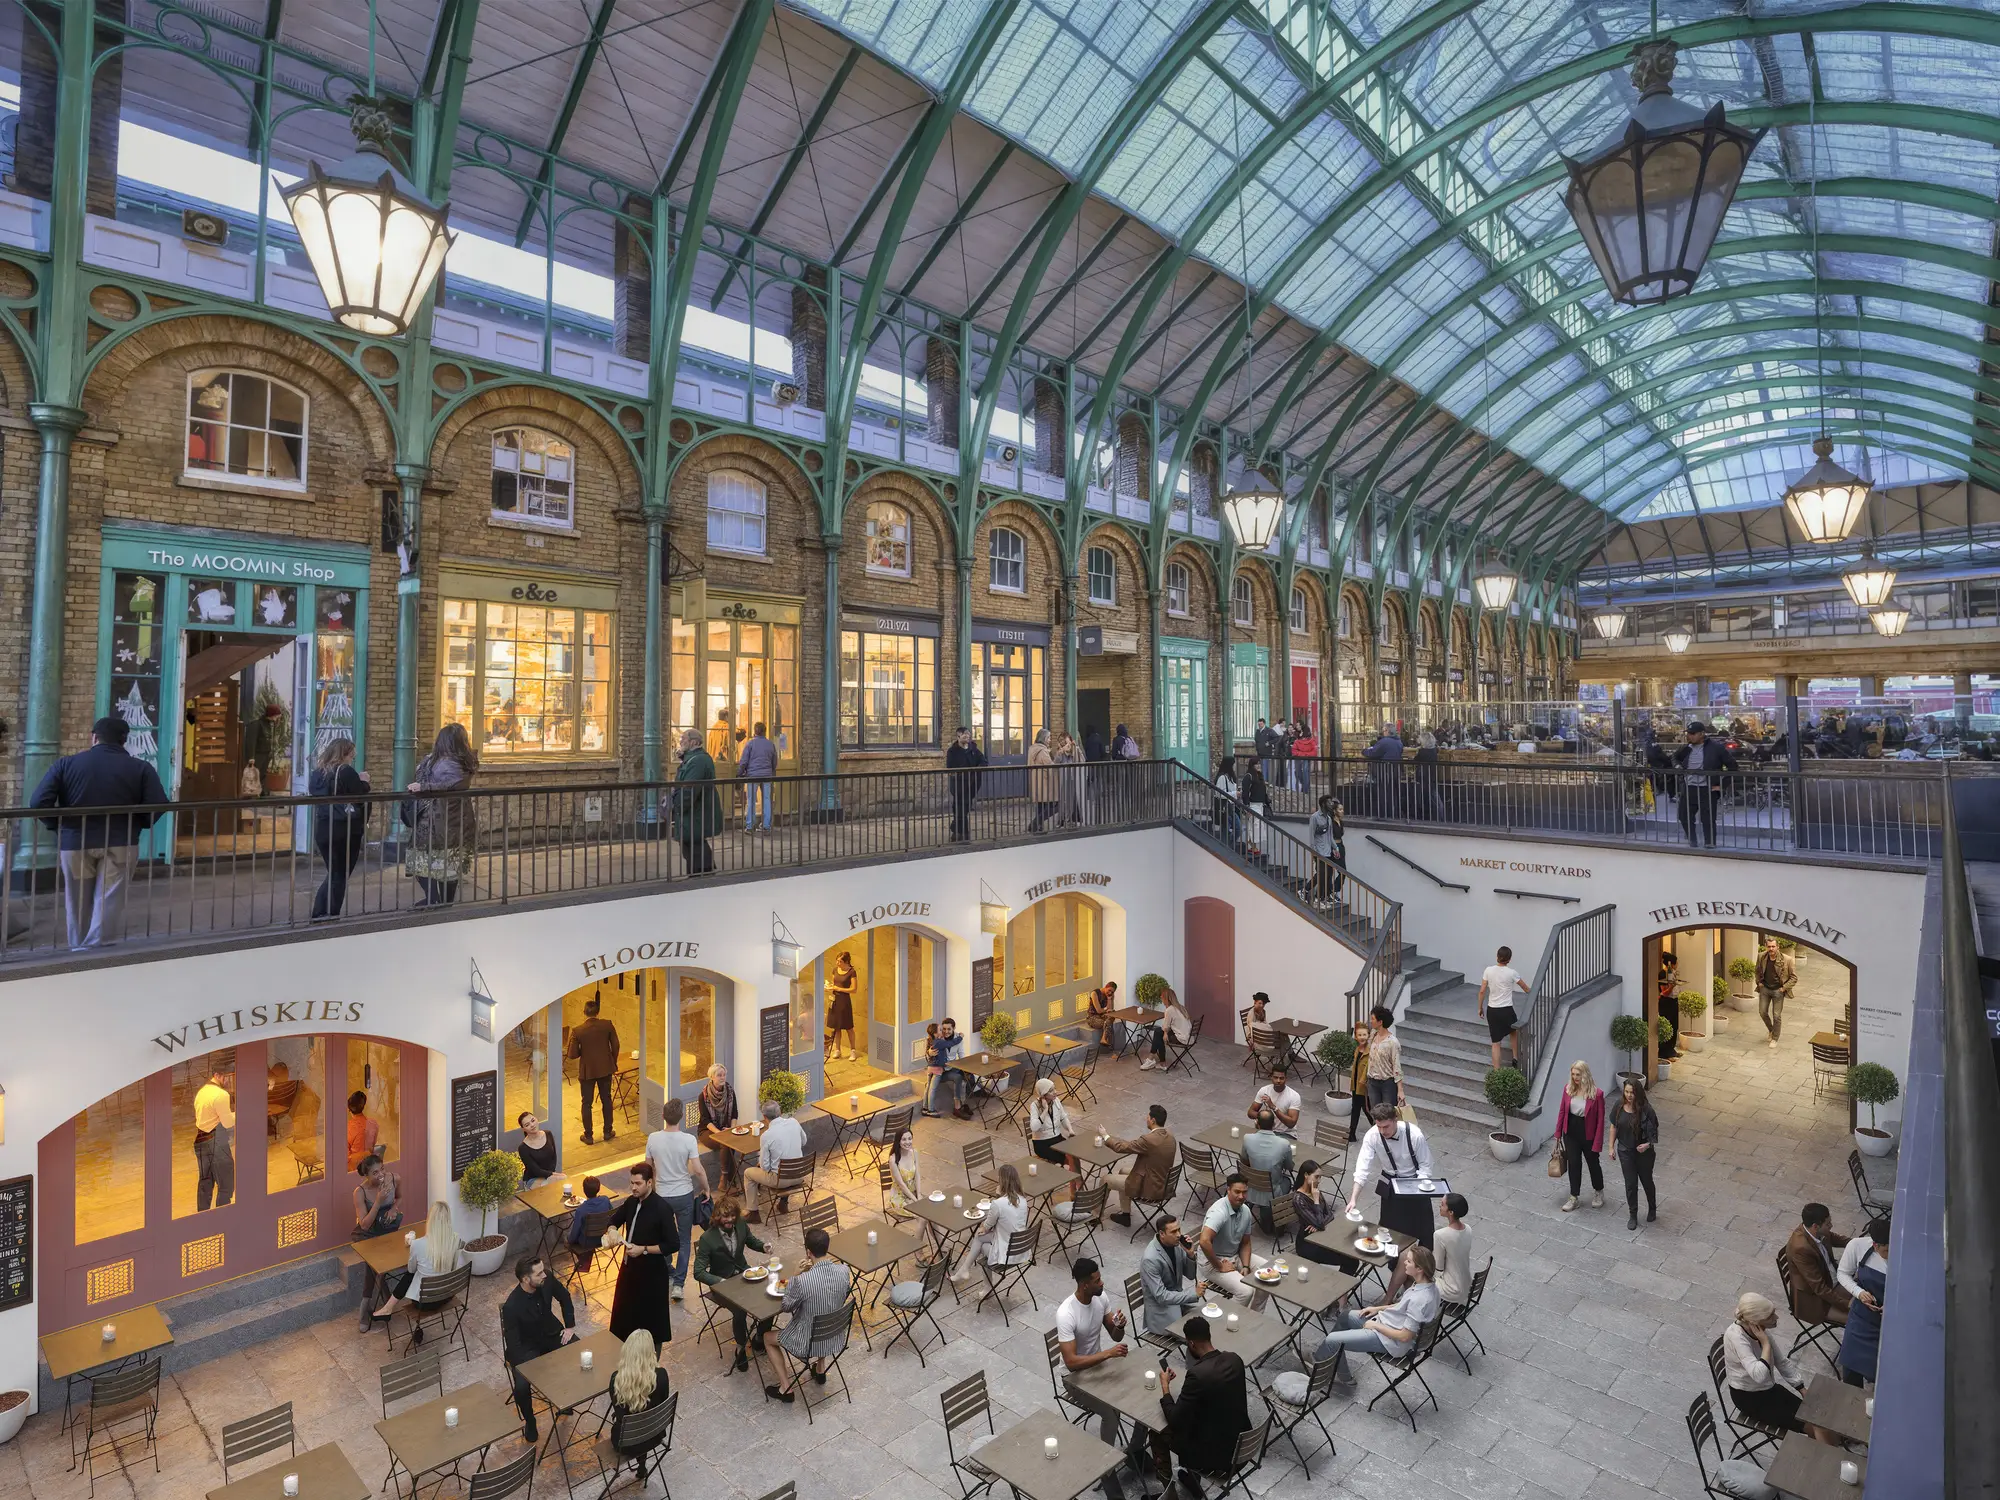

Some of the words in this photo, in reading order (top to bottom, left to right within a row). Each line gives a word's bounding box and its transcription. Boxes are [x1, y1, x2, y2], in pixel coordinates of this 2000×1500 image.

[148, 550, 185, 566] The
[191, 553, 286, 576] MOOMIN
[292, 562, 335, 581] Shop
[511, 582, 558, 602] e&e
[1460, 857, 1507, 870] MARKET
[1509, 861, 1592, 878] COURTYARDS
[1024, 879, 1053, 901] THE
[1056, 873, 1077, 888] PIE
[1079, 872, 1112, 887] SHOP
[848, 901, 931, 931] FLOOZIE
[1649, 903, 1690, 923] THE
[1696, 901, 1847, 945] RESTAURANT
[580, 941, 700, 978] FLOOZIE
[151, 1000, 364, 1053] WHISKIES
